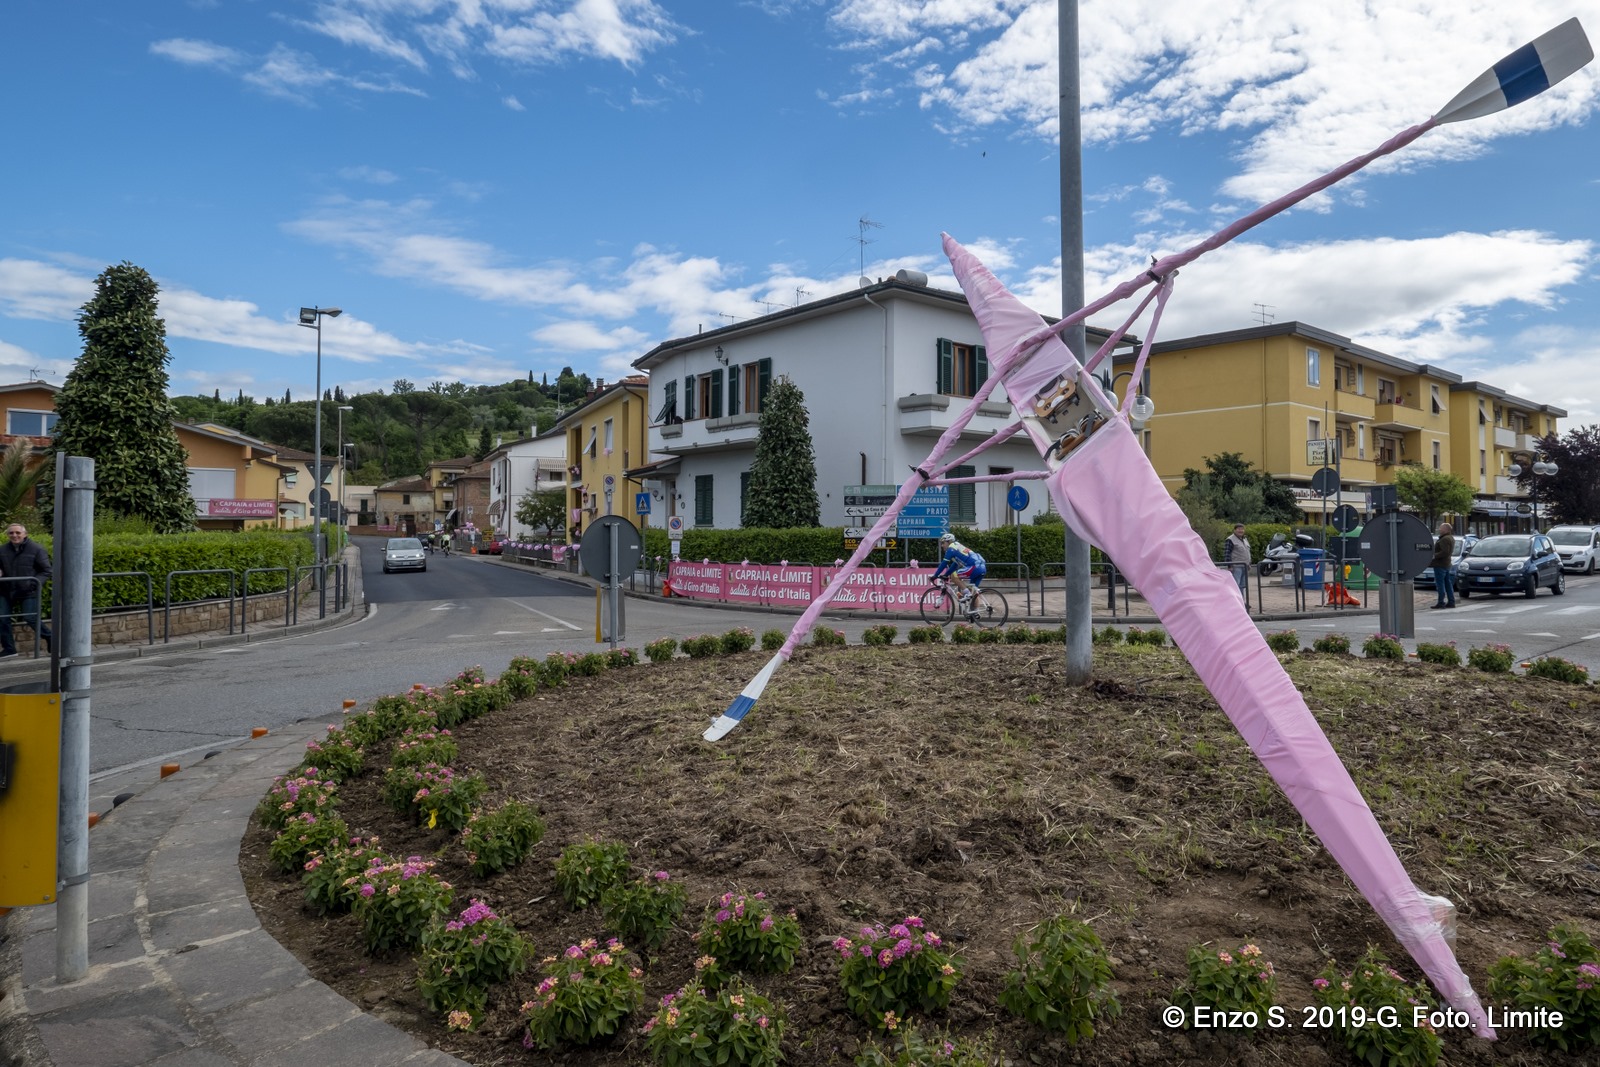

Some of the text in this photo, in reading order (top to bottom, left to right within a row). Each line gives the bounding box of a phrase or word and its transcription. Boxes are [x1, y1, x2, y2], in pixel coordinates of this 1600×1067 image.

[675, 566, 722, 579] CAPRAIA e LIMITE
[735, 569, 813, 583] CAPRAIA e LIMITE
[846, 573, 887, 585] PRAIA
[889, 576, 897, 586] e
[687, 581, 700, 592] Giro
[700, 582, 720, 594] d'Italia
[729, 583, 811, 600] saluta il Giro d'Italia
[859, 588, 869, 603] il
[869, 591, 895, 603] Giro
